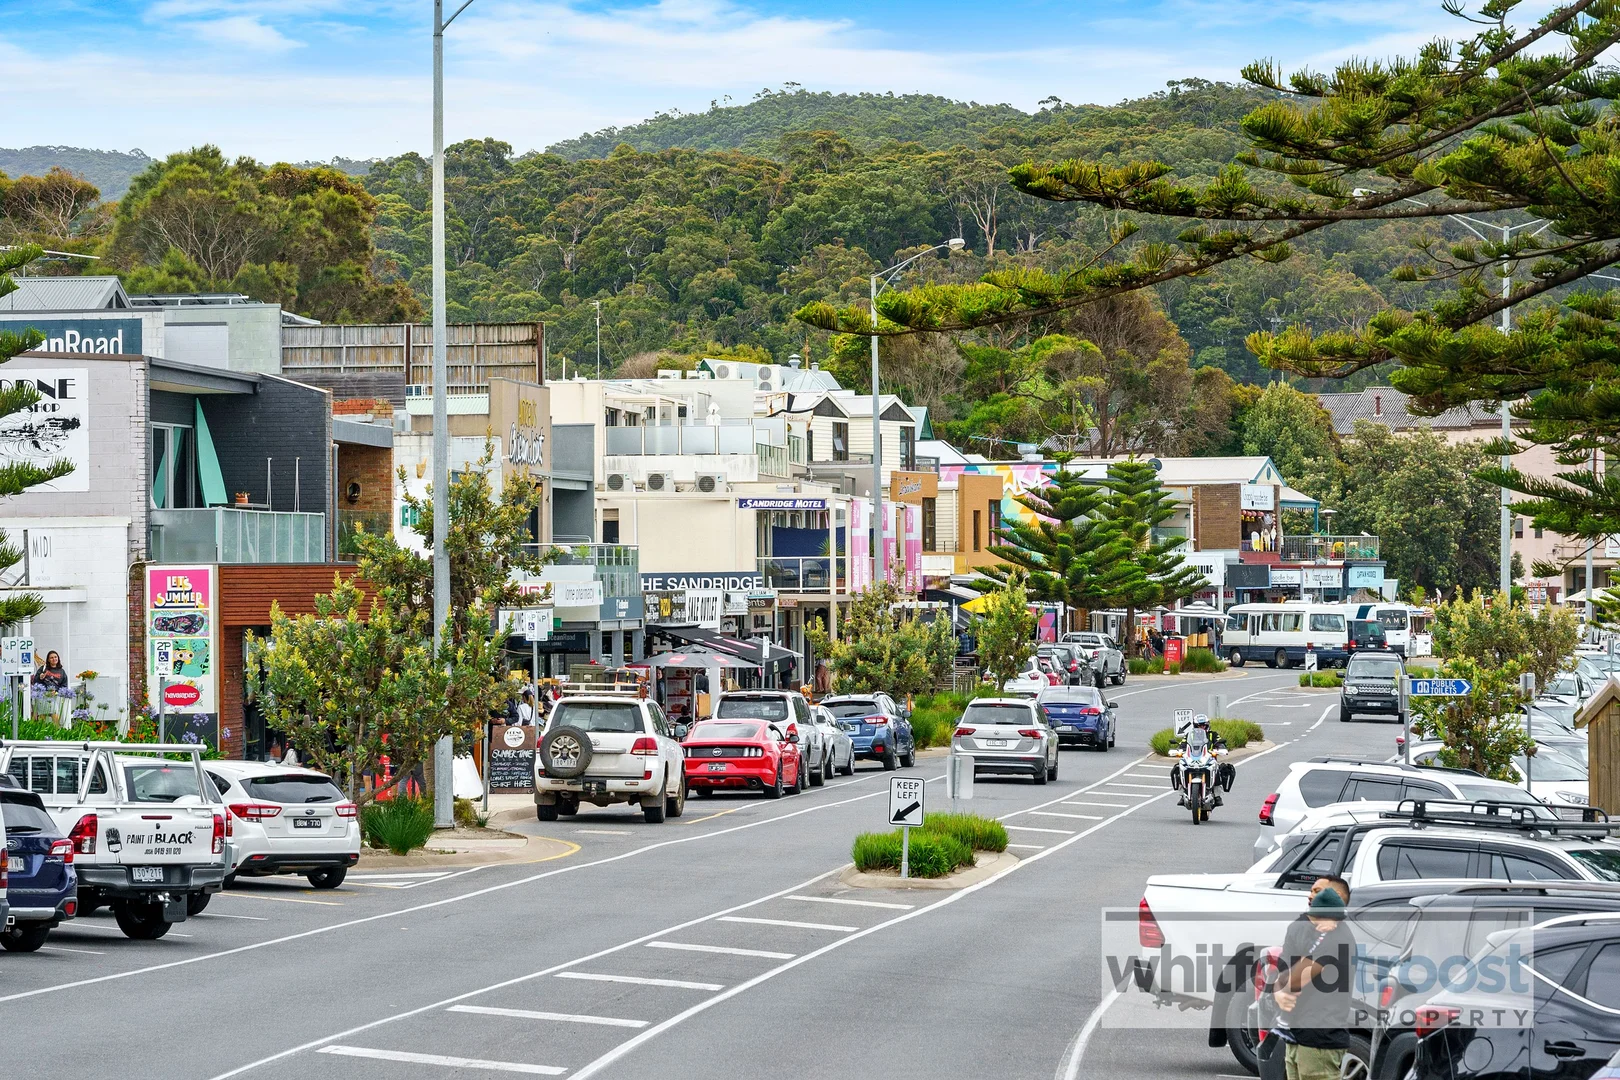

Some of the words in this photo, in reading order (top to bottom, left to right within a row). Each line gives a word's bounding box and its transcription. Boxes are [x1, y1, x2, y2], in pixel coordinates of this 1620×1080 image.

[26, 328, 122, 354] anRoad
[26, 403, 60, 413] SHOP
[742, 498, 794, 508] SANDRIDGE
[794, 498, 822, 508] MOTEL
[32, 536, 52, 558] MIDI
[1188, 565, 1213, 574] THING
[641, 578, 663, 590] HE
[667, 576, 763, 590] SANDRIDGE
[154, 592, 204, 608] SUMMER
[20, 641, 33, 650] 2P
[156, 642, 171, 650] 2P
[896, 781, 920, 790] KEEP
[897, 791, 918, 800] LEFT
[126, 835, 145, 844] PAINT
[148, 835, 153, 844] IT
[155, 833, 192, 844] BLACK
